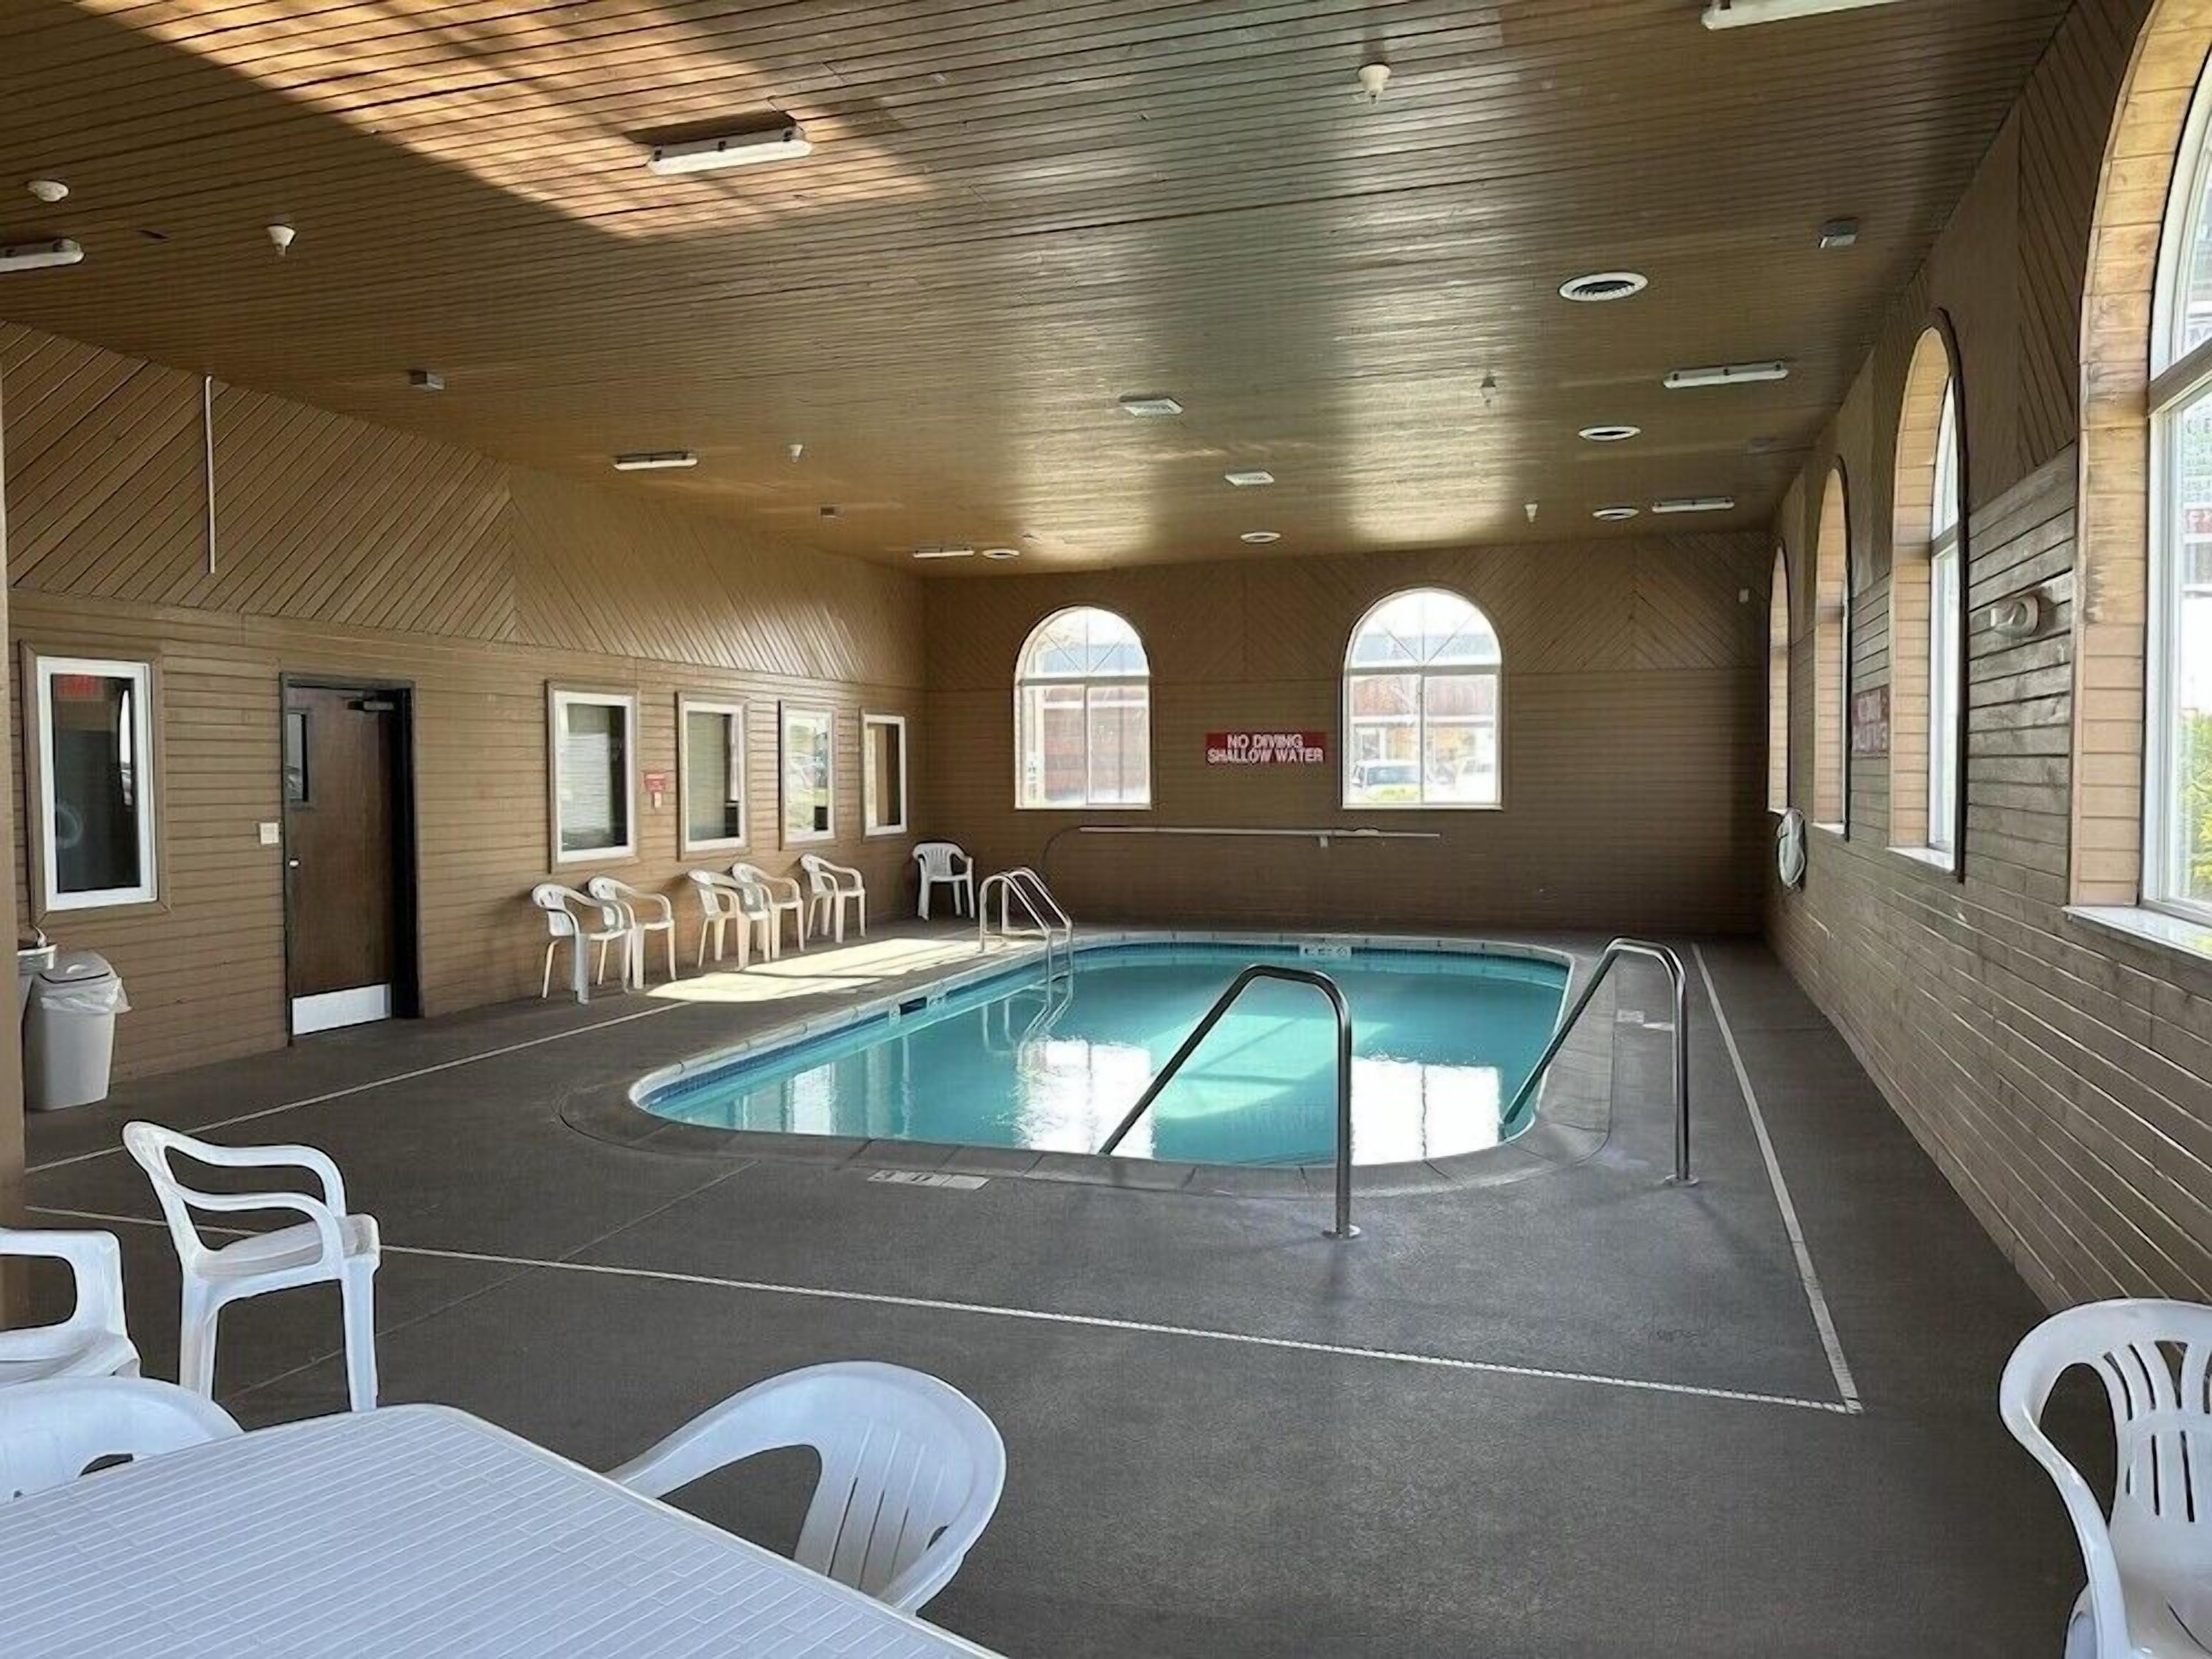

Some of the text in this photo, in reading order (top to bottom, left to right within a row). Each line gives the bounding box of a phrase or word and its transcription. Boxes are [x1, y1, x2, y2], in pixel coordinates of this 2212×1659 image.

[1227, 734, 1303, 748] NO DIVING
[1207, 748, 1324, 763] SHALLOW WATER
